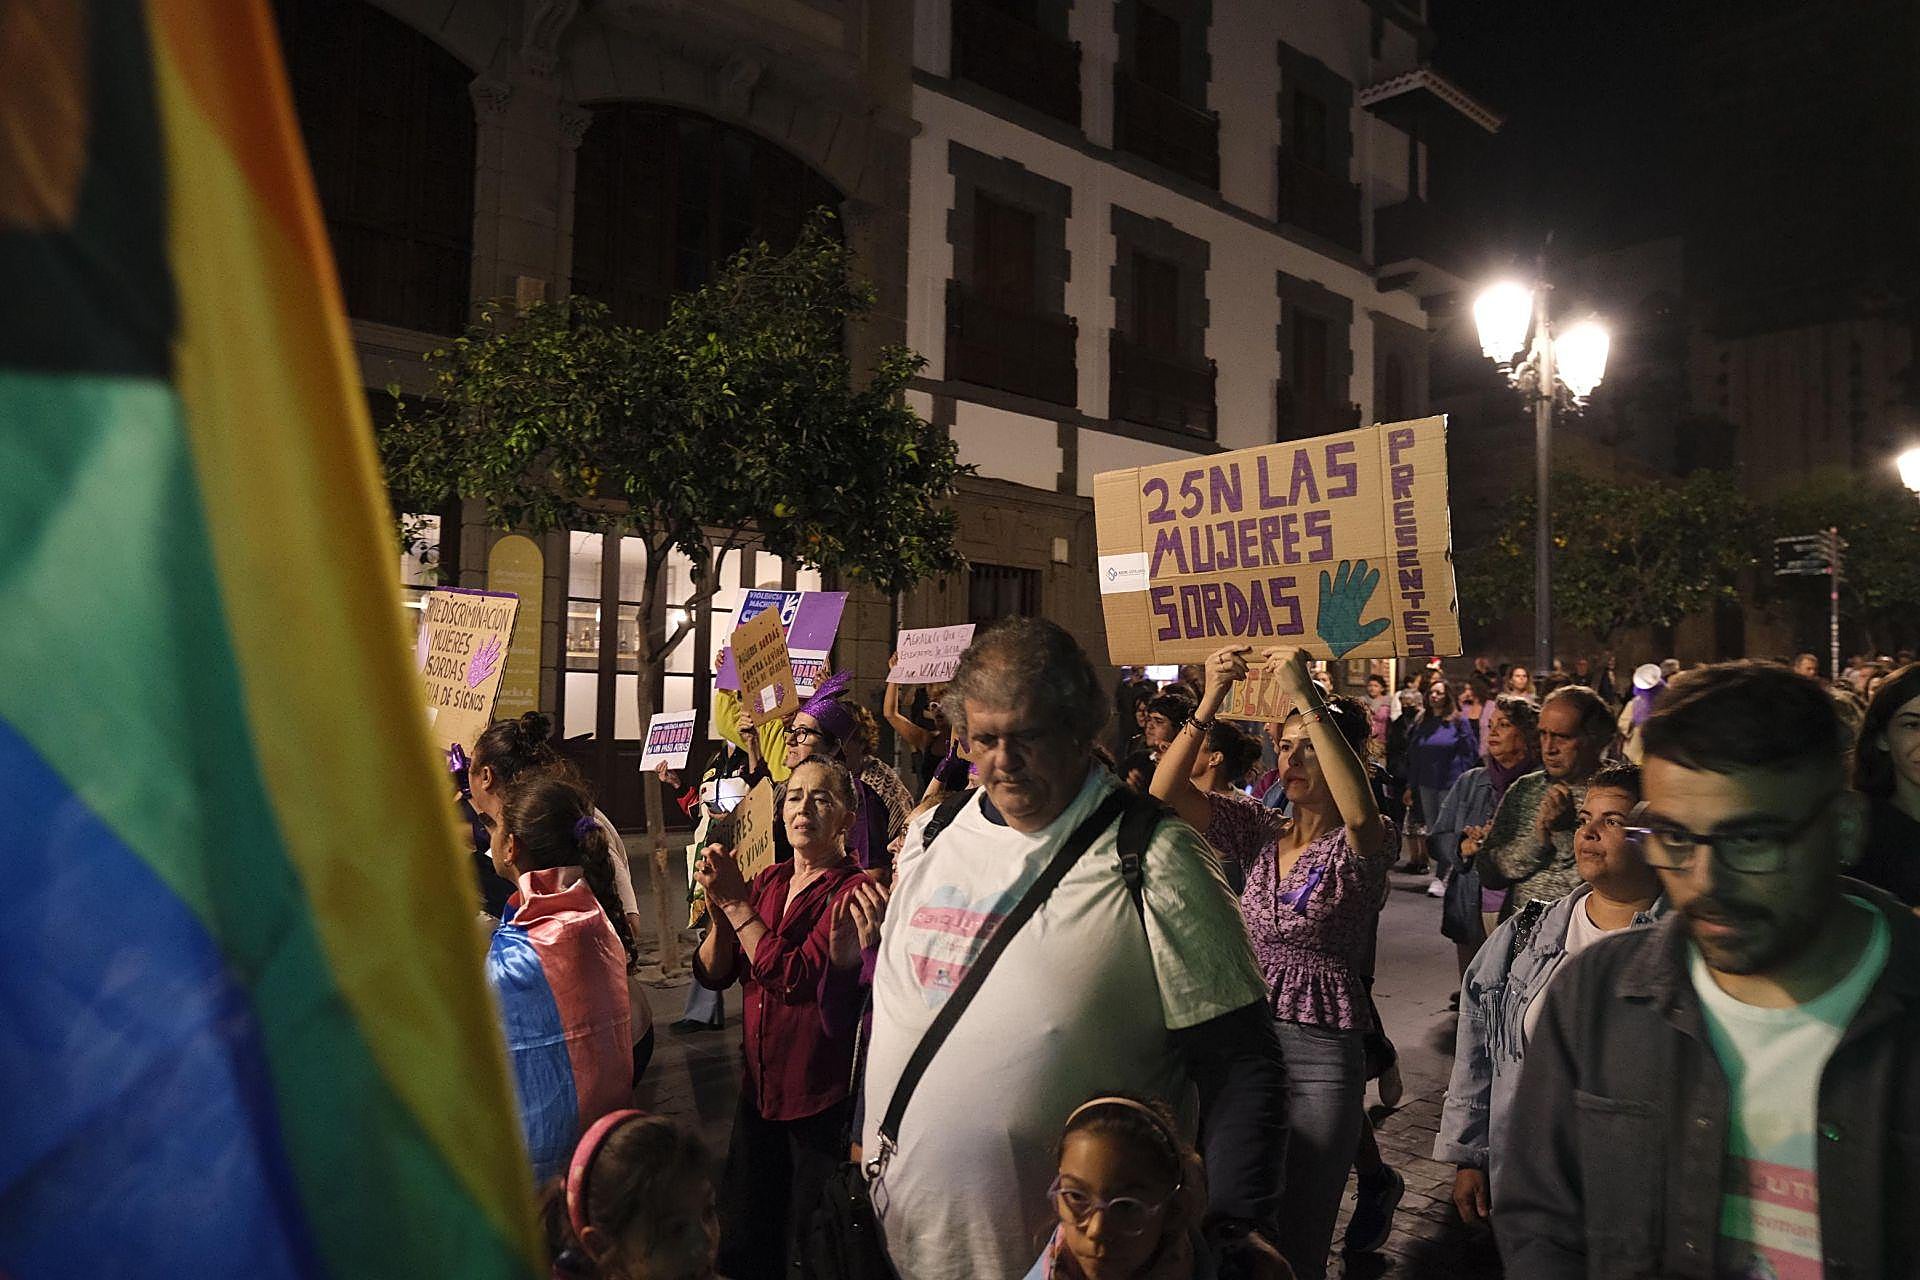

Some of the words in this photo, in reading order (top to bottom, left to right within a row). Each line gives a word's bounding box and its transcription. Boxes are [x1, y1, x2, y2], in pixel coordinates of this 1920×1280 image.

[1143, 463, 1243, 524] 25N
[1257, 441, 1358, 510] LAS
[1149, 510, 1334, 578] MUJERES
[1387, 428, 1434, 657] PRESENTES
[430, 628, 474, 656] MUJERES
[1148, 576, 1304, 642] SORDAS
[426, 655, 467, 682] SORDAS
[441, 686, 453, 707] DE
